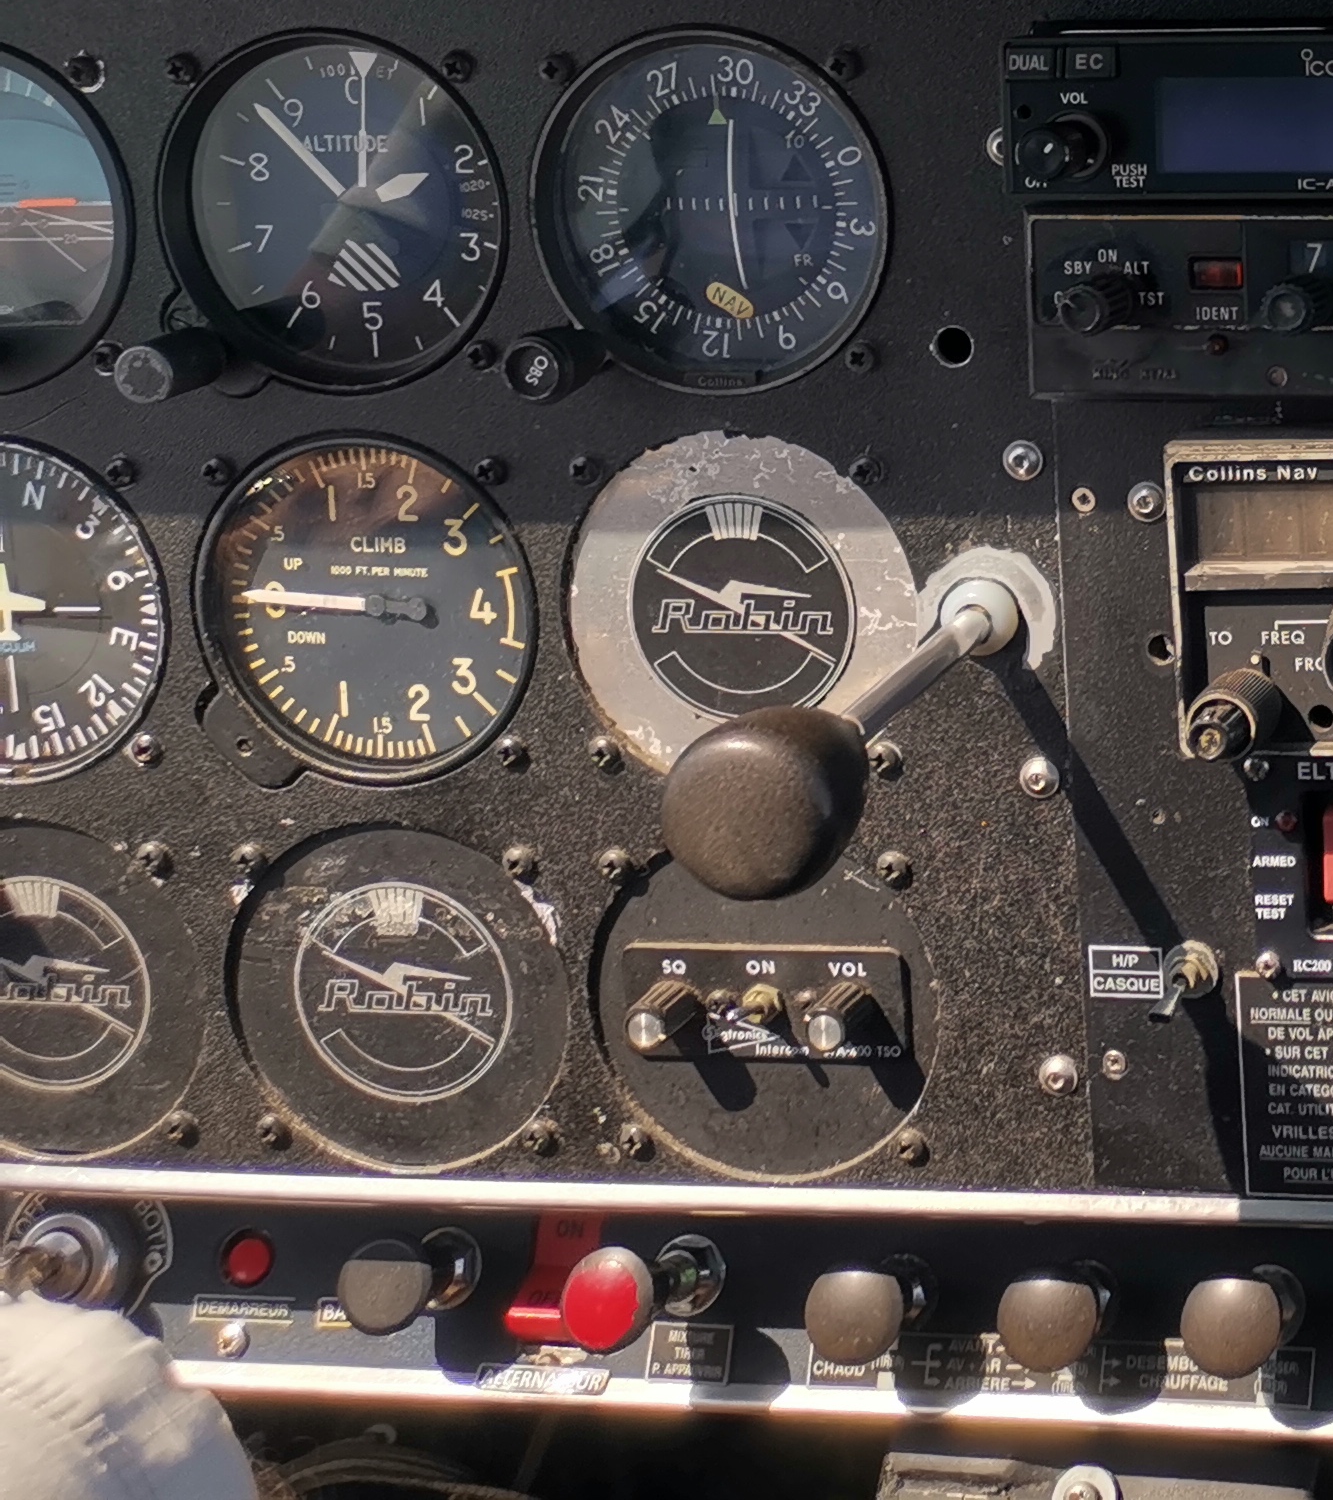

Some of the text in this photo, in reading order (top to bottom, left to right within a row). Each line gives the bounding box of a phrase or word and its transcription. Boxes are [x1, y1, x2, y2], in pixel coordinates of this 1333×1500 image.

[717, 56, 754, 83] 30
[1008, 54, 1050, 71] DUAL
[784, 80, 821, 116] 33
[594, 105, 630, 144] 24
[302, 135, 389, 152] ALTITUDE
[453, 145, 474, 174] 2
[837, 146, 862, 166] 0
[1111, 164, 1148, 177] PUSH
[577, 175, 603, 202] 21
[1113, 176, 1145, 188] TEST
[850, 217, 875, 236] 3
[254, 224, 273, 252] 7
[459, 233, 480, 261] 3
[1064, 261, 1093, 275] SBY
[1123, 261, 1150, 275] ALT
[422, 279, 445, 307] 4
[1138, 292, 1165, 305] TST
[363, 302, 383, 330] 5
[1195, 307, 1240, 321] IDENT
[701, 329, 731, 358] 12
[1188, 465, 1318, 482] Collins Nav
[22, 481, 46, 510] N
[396, 485, 419, 522] 2
[350, 537, 406, 553] CLIMB
[443, 519, 468, 555] 3
[469, 588, 497, 624] 4
[651, 598, 834, 635] Robin
[109, 627, 139, 651] E
[287, 631, 326, 645] DOWN
[1261, 631, 1305, 646] FREQ
[452, 658, 476, 694] 3
[407, 683, 430, 721] 2
[32, 702, 66, 733] 15
[1251, 816, 1270, 827] ON
[1252, 856, 1296, 868] ARMED
[1254, 894, 1294, 906] RESET
[1255, 908, 1287, 920] TEST
[661, 959, 867, 977] SQ ON VOL
[1112, 954, 1139, 968] H/P
[1292, 959, 1332, 973] RC200
[1093, 977, 1161, 992] CASQUE
[318, 978, 494, 1016] Robin
[1282, 990, 1307, 1003] CET
[1250, 1007, 1311, 1021] NORMALE
[1315, 1009, 1333, 1021] OU
[1268, 1028, 1285, 1040] DE
[1289, 1028, 1314, 1041] VOL
[943, 1377, 1010, 1392] ARRIERE
[1139, 1374, 1229, 1392] CHAUFFAGE
